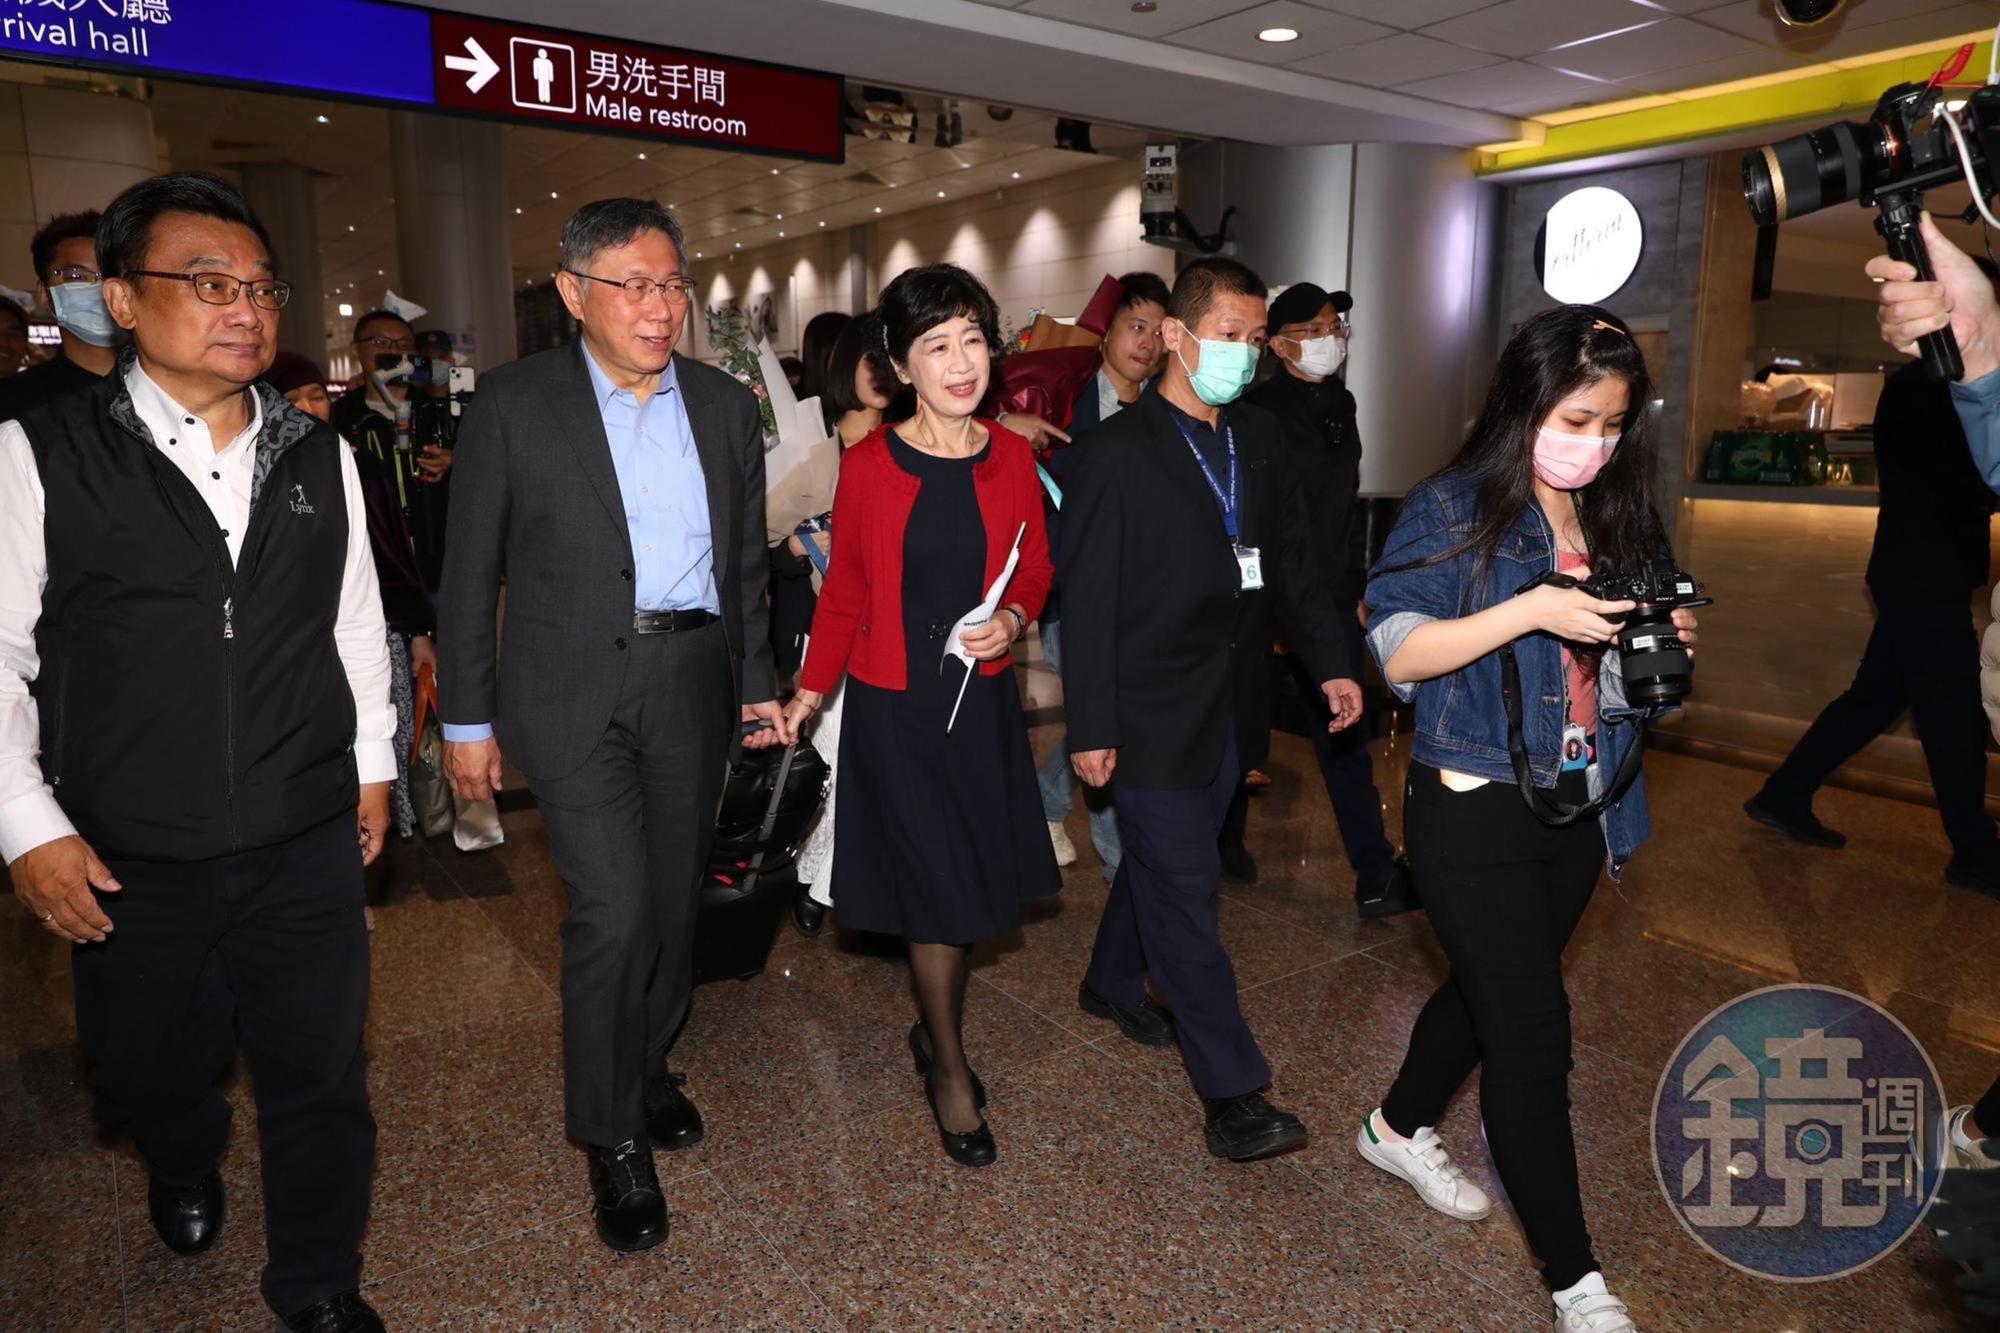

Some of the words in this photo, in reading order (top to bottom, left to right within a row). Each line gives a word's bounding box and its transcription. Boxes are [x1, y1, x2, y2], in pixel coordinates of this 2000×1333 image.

[0, 12, 77, 47] rival
[88, 20, 149, 57] hall
[586, 50, 726, 107] 男洗手間
[586, 94, 642, 123] Male
[649, 108, 747, 136] restroom
[1247, 564, 1257, 580] 6
